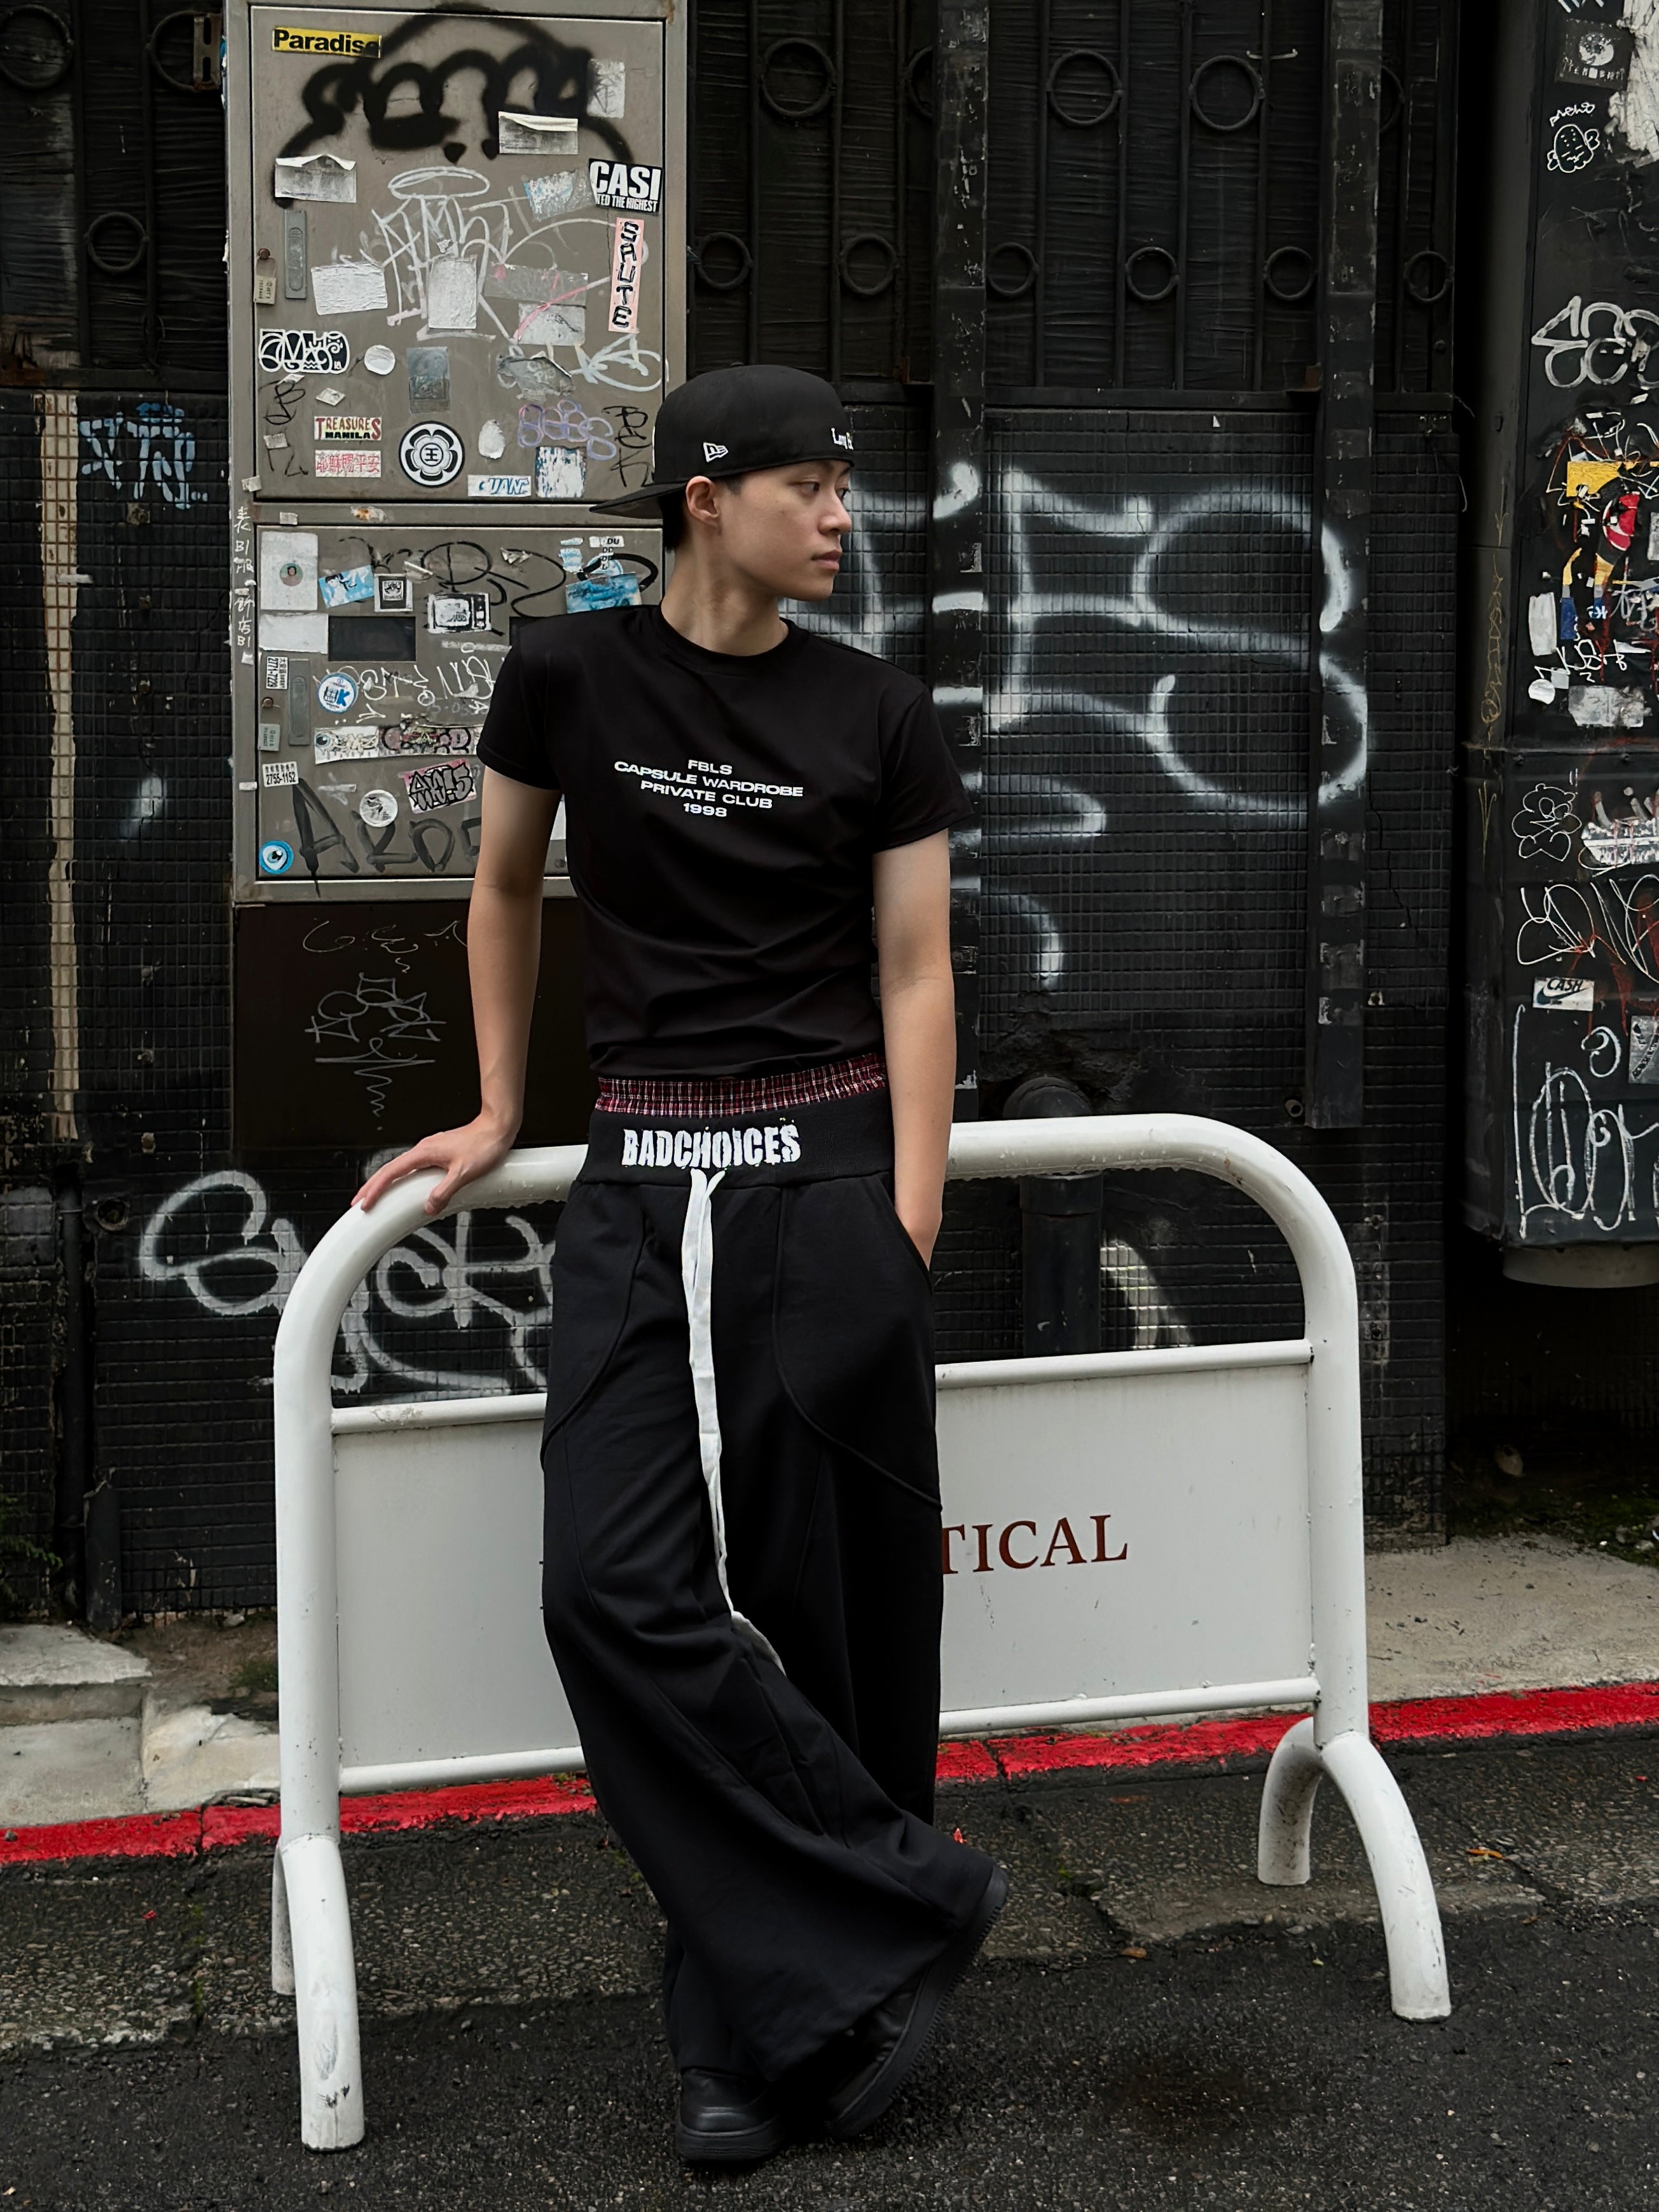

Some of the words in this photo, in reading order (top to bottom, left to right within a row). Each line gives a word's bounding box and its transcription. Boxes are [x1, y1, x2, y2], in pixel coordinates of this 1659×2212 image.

[612, 195, 626, 209] THE
[626, 197, 658, 212] HIGHEST
[612, 221, 638, 327] SAUTE
[315, 418, 381, 440] TREASURES
[268, 658, 279, 687] 2771-7229
[266, 771, 296, 785] 2755-1152
[688, 760, 732, 774] FBLS
[614, 761, 697, 784] CAPSULE
[702, 776, 803, 796] WARDROBE
[640, 780, 715, 802] PRIVATE
[722, 794, 772, 809] CLUB
[684, 803, 727, 817] 1998
[1547, 978, 1583, 992] CASH
[622, 1124, 801, 1169] BADCHOICES
